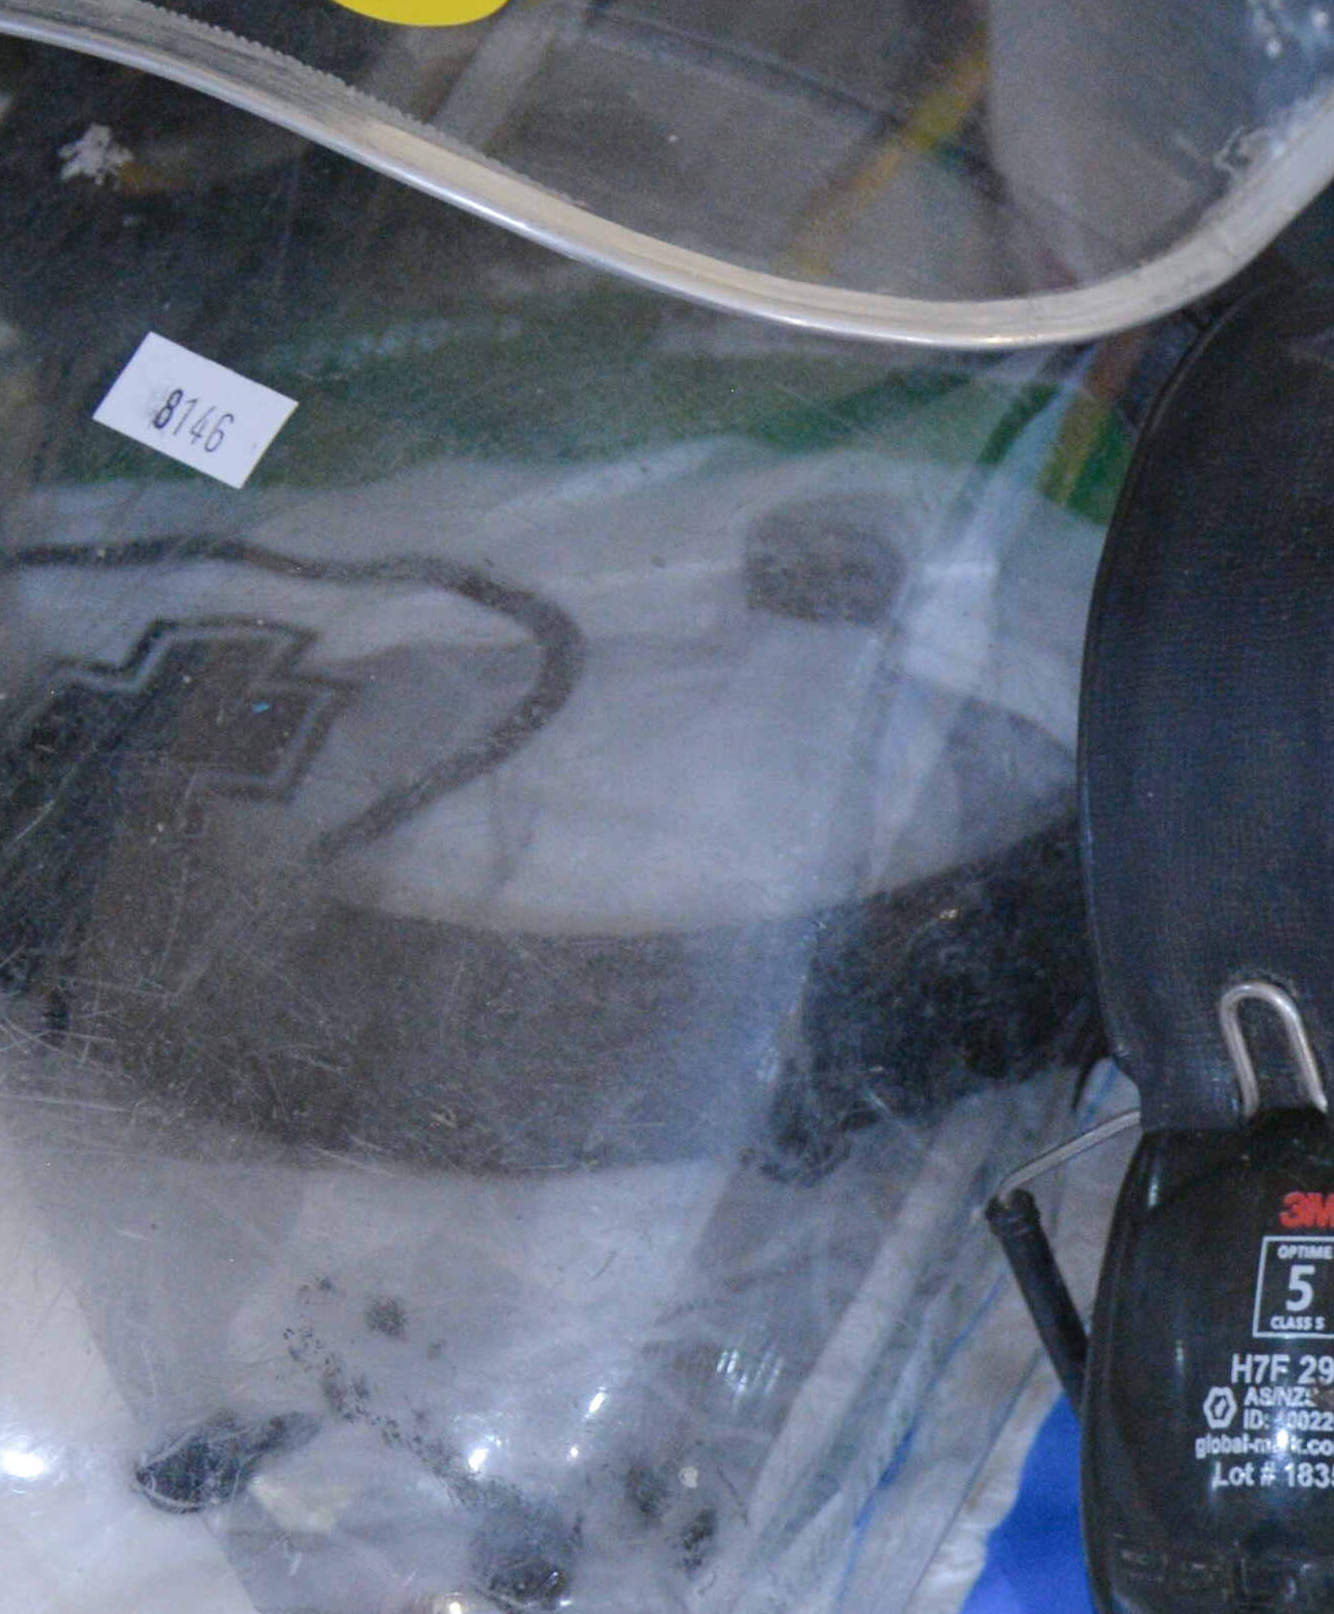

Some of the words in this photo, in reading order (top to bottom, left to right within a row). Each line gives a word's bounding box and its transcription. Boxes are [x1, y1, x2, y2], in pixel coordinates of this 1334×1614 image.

[154, 387, 236, 456] 8146
[1277, 1244, 1334, 1260] OPTIME
[1285, 1264, 1316, 1312] 5
[1270, 1316, 1310, 1330] CLASS
[1230, 1353, 1291, 1384] H7F
[1243, 1408, 1270, 1430] ID:
[1212, 1462, 1255, 1488] Lot
[1260, 1462, 1276, 1487] #
